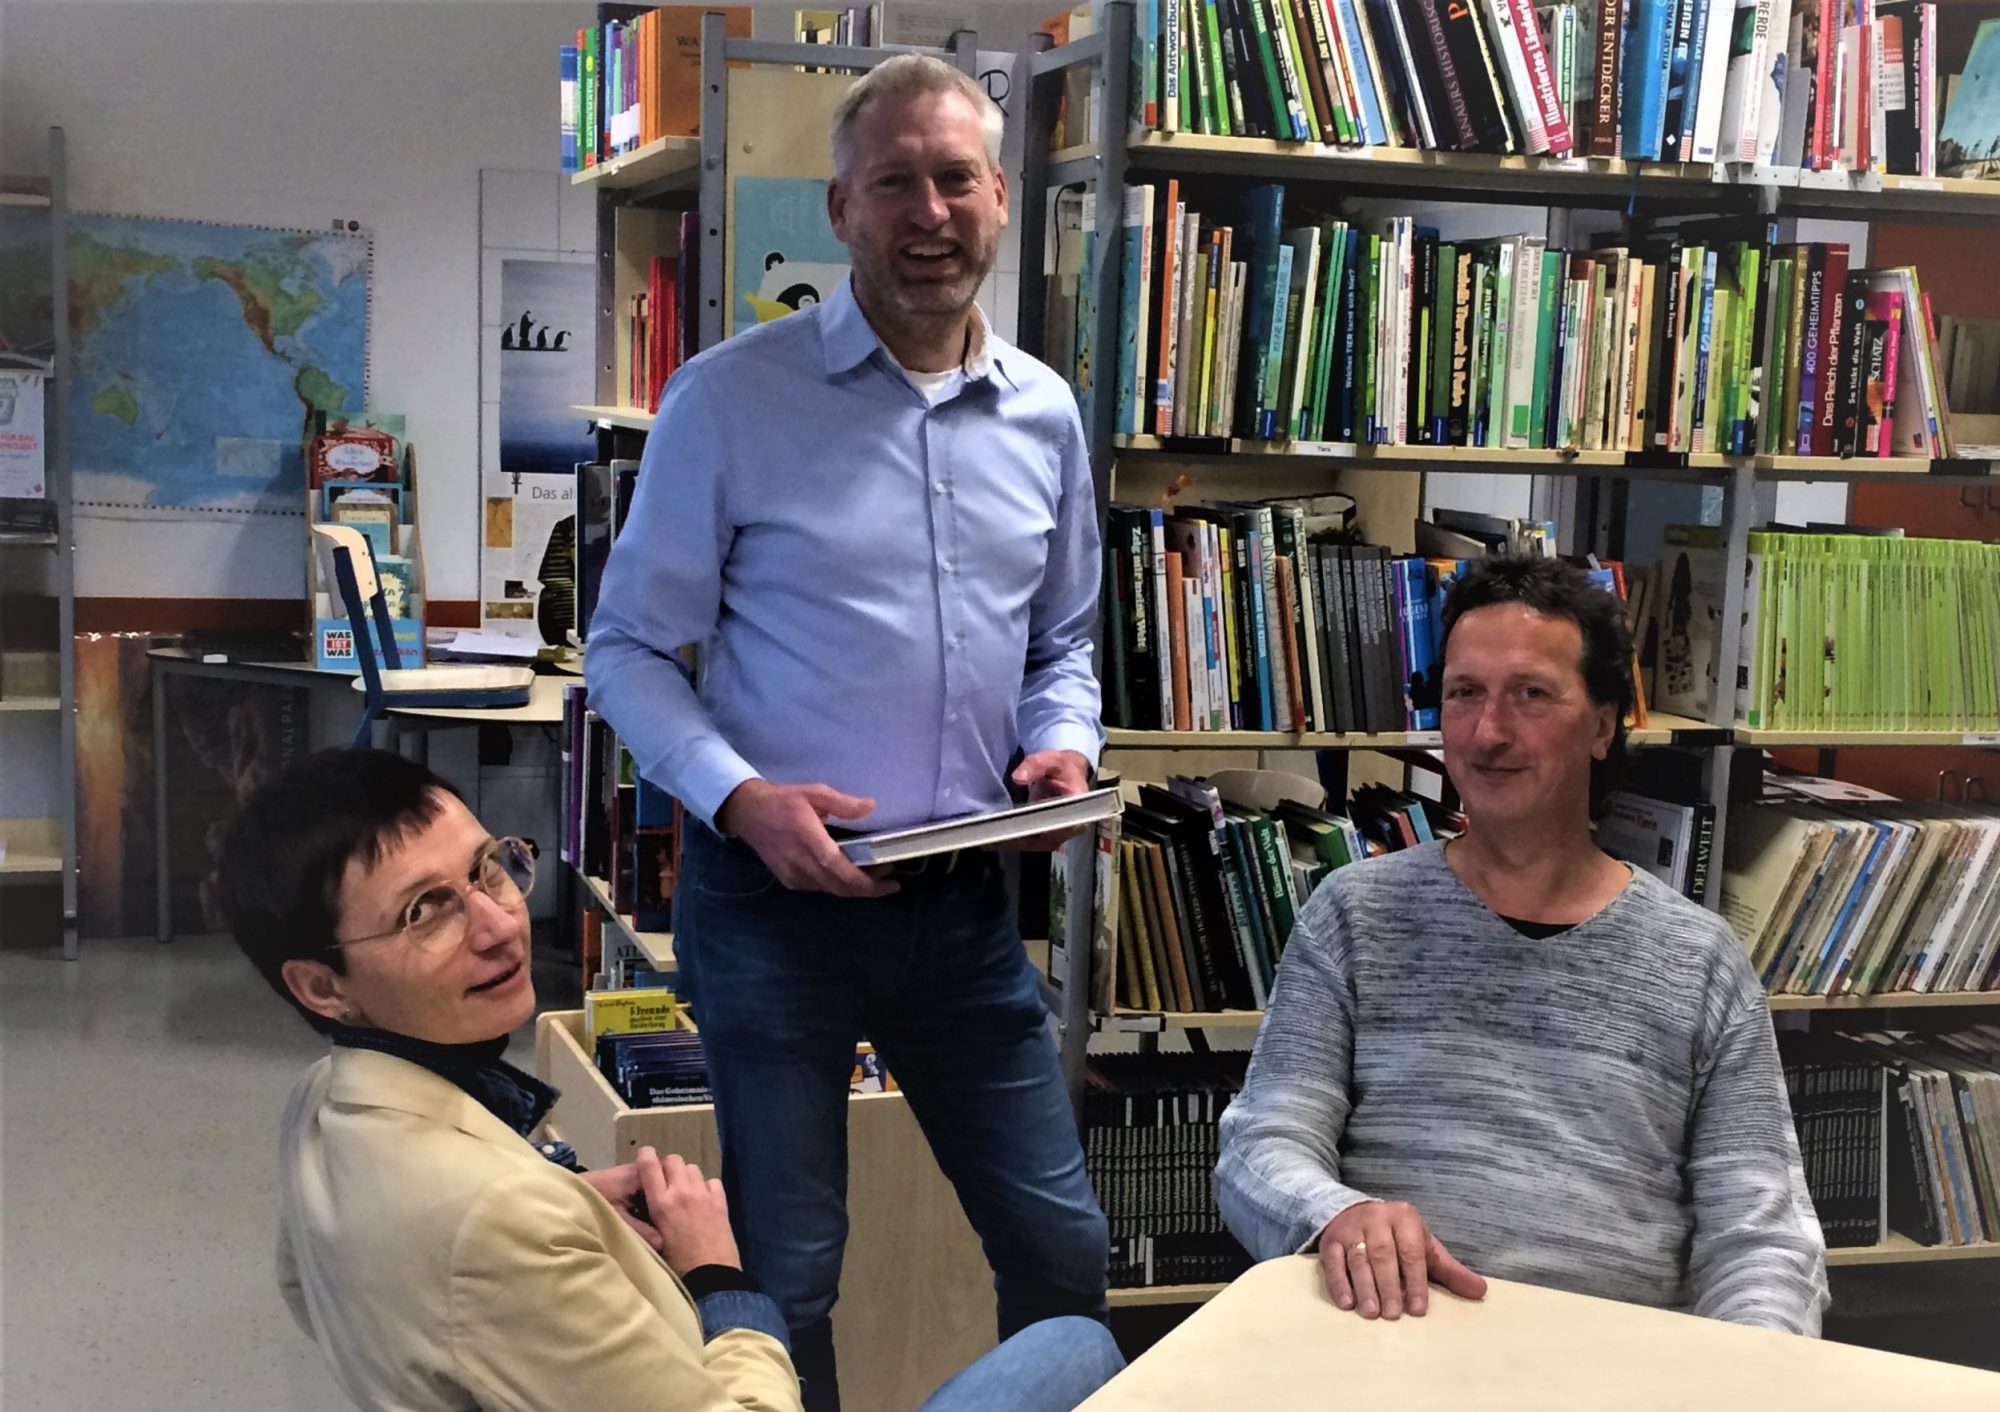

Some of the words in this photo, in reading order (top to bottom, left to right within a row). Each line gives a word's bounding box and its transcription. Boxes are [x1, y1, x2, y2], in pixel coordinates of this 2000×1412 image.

[1678, 43, 1688, 60] ZU
[1167, 77, 1177, 98] Das
[1599, 30, 1614, 123] ENTDECKER
[1530, 50, 1562, 126] Illustriertes
[1449, 81, 1473, 138] KNAURS
[1348, 269, 1356, 290] hier?
[1171, 301, 1179, 314] der
[1484, 288, 1493, 318] NATUR
[1808, 271, 1822, 349] GEHEIMTIPPS
[1829, 293, 1843, 345] Pflanzen
[1853, 322, 1862, 346] Welt
[1806, 352, 1816, 374] 400
[1828, 346, 1839, 365] der
[1851, 349, 1859, 364] die
[1871, 337, 1884, 380] SCHATZ
[1345, 355, 1353, 388] Welches
[1849, 367, 1858, 389] tickt
[1824, 367, 1837, 401] Reich
[1848, 391, 1857, 404] So
[1823, 402, 1835, 426] Das
[532, 487, 557, 500] Das
[1131, 527, 1142, 553] Zeig
[1259, 510, 1277, 591] WANDER
[326, 631, 351, 639] WAS
[326, 648, 351, 656] WAS
[1266, 848, 1276, 864] der
[636, 1004, 670, 1015] Freunde
